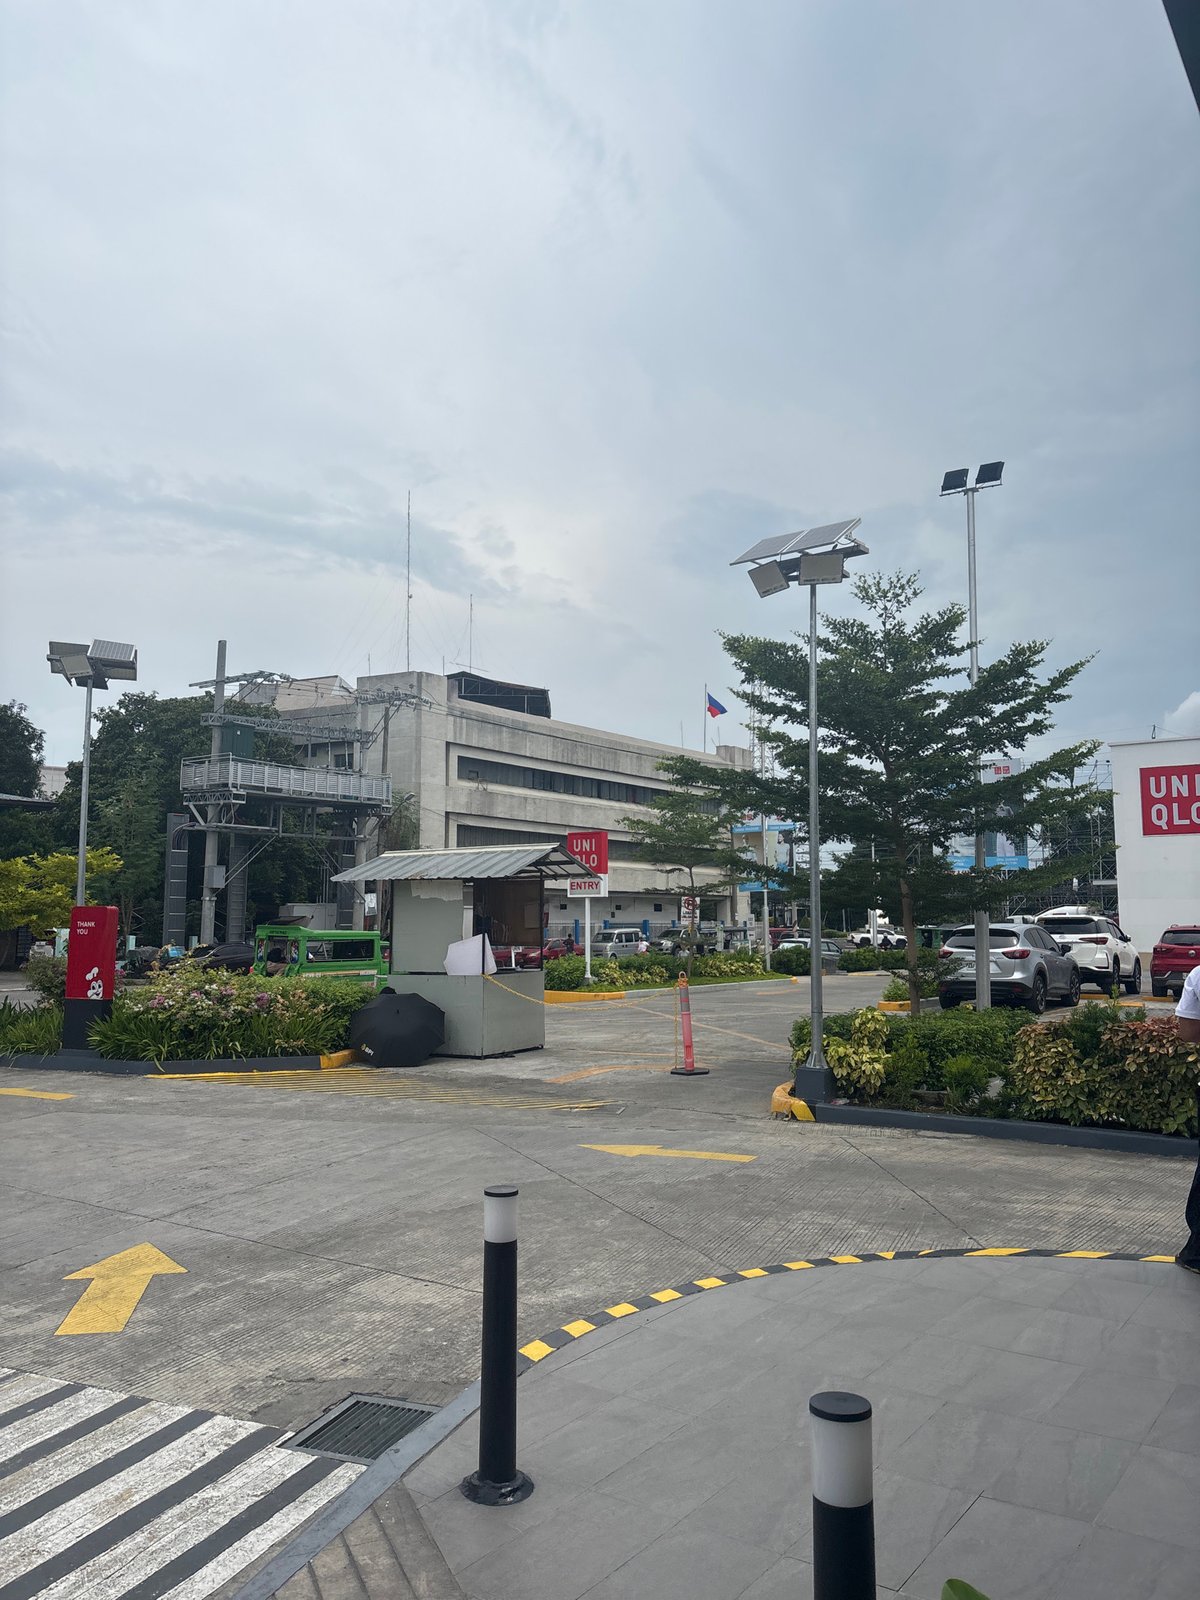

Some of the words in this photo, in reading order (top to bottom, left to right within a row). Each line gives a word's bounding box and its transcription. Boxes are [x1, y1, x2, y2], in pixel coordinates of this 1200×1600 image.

[1150, 774, 1200, 798] UNI
[574, 839, 595, 852] UNI
[570, 881, 599, 890] ENTRY
